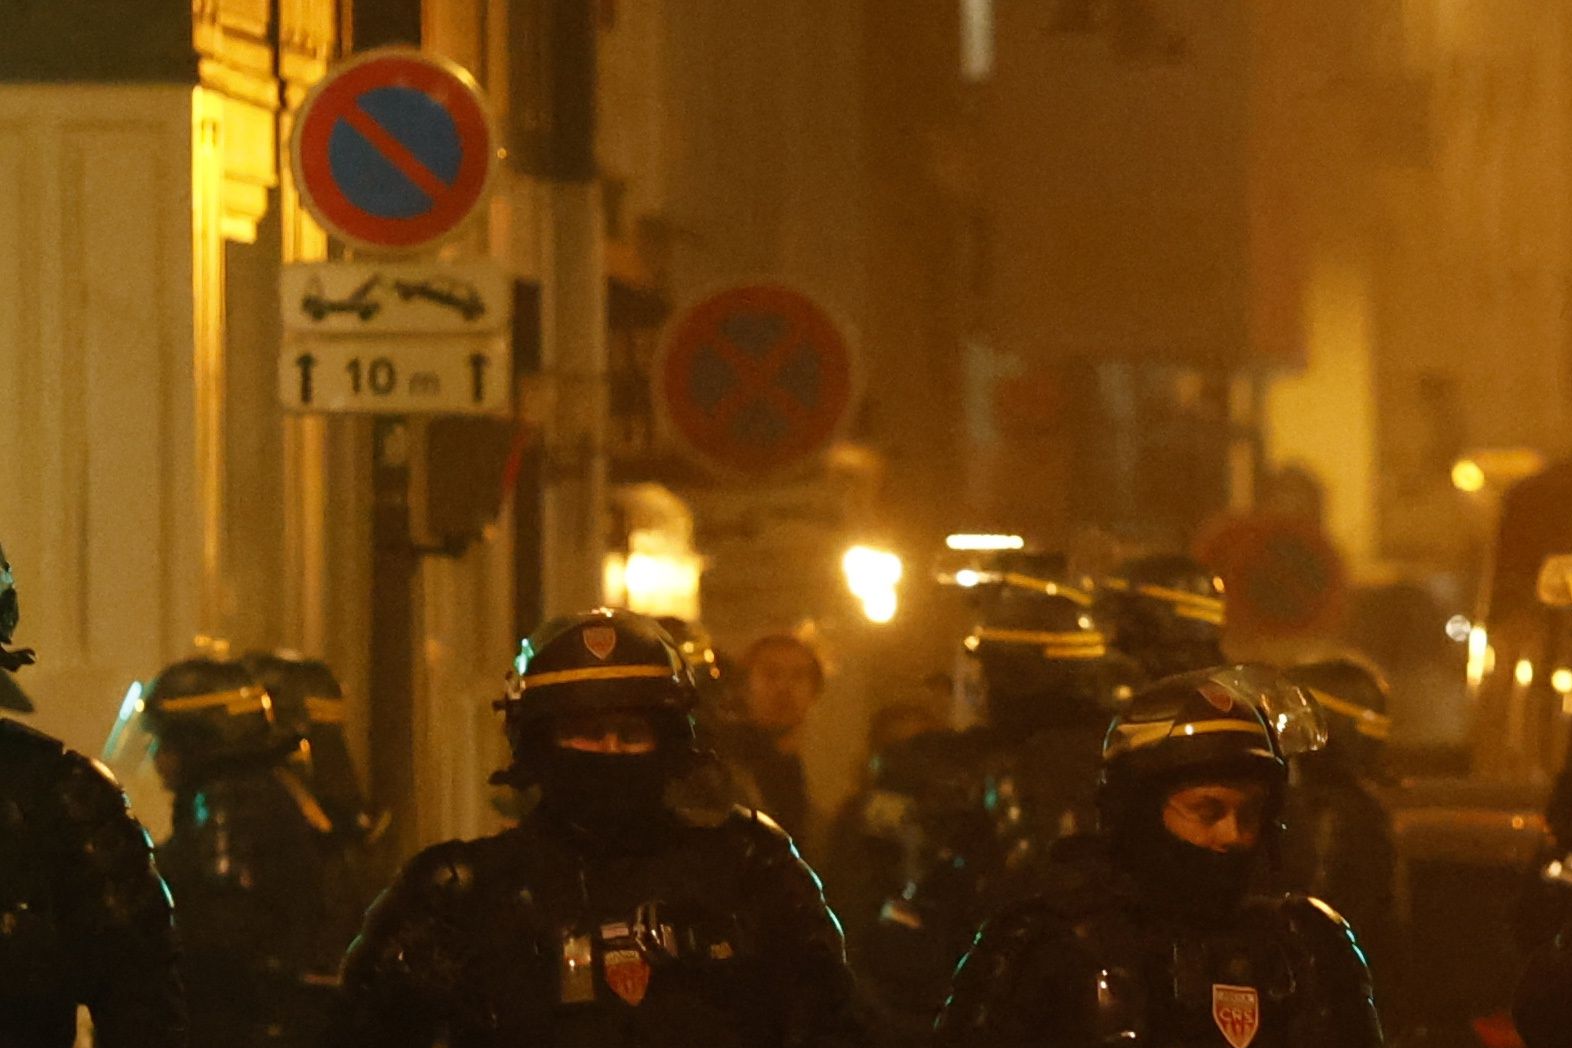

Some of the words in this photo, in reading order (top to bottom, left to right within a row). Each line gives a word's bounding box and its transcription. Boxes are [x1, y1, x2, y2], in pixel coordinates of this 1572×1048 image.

[346, 357, 396, 396] 10
[408, 372, 441, 396] m
[1219, 1007, 1254, 1024] CRS
